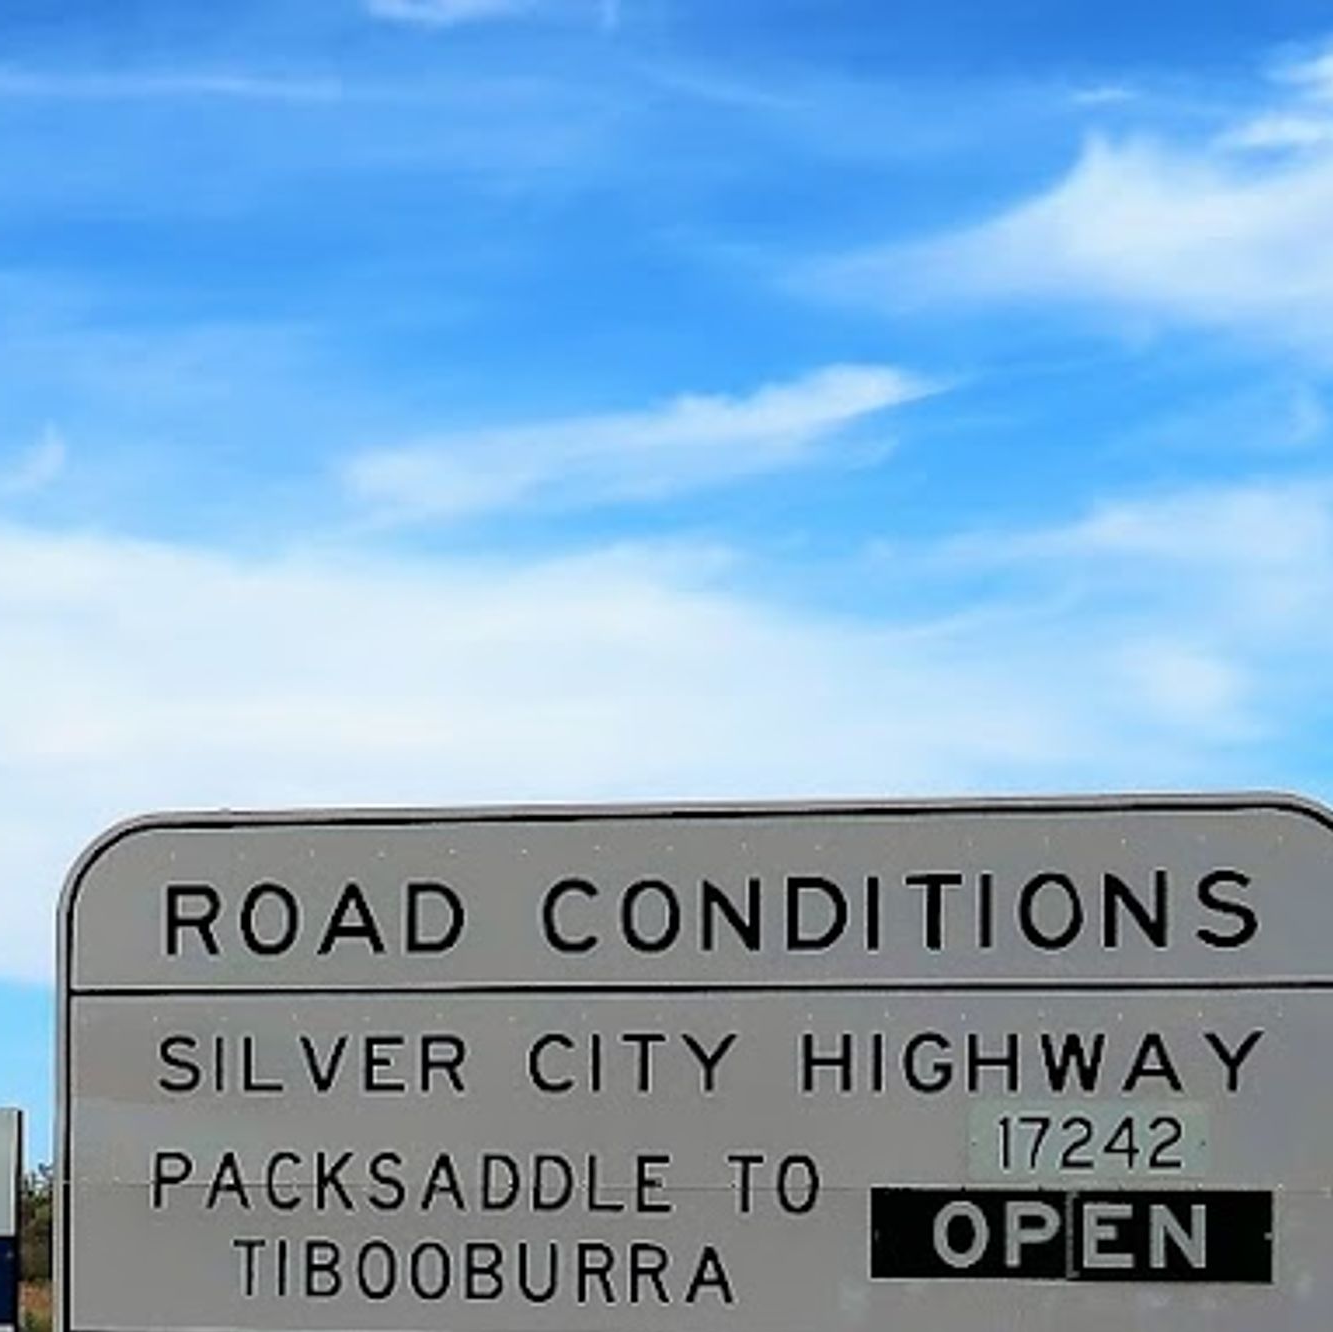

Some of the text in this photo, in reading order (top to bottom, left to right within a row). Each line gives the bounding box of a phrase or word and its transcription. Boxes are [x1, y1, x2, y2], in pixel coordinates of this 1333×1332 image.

[166, 870, 1259, 956] ROAD CONDITIONS
[158, 1032, 1266, 1094] SILVER CITY HIGHWAY
[998, 1116, 1184, 1170] 17242
[153, 1151, 820, 1213] PACKSADDLE TO
[934, 1201, 1207, 1270] OPEN
[233, 1239, 734, 1304] TIBOOBURRA
